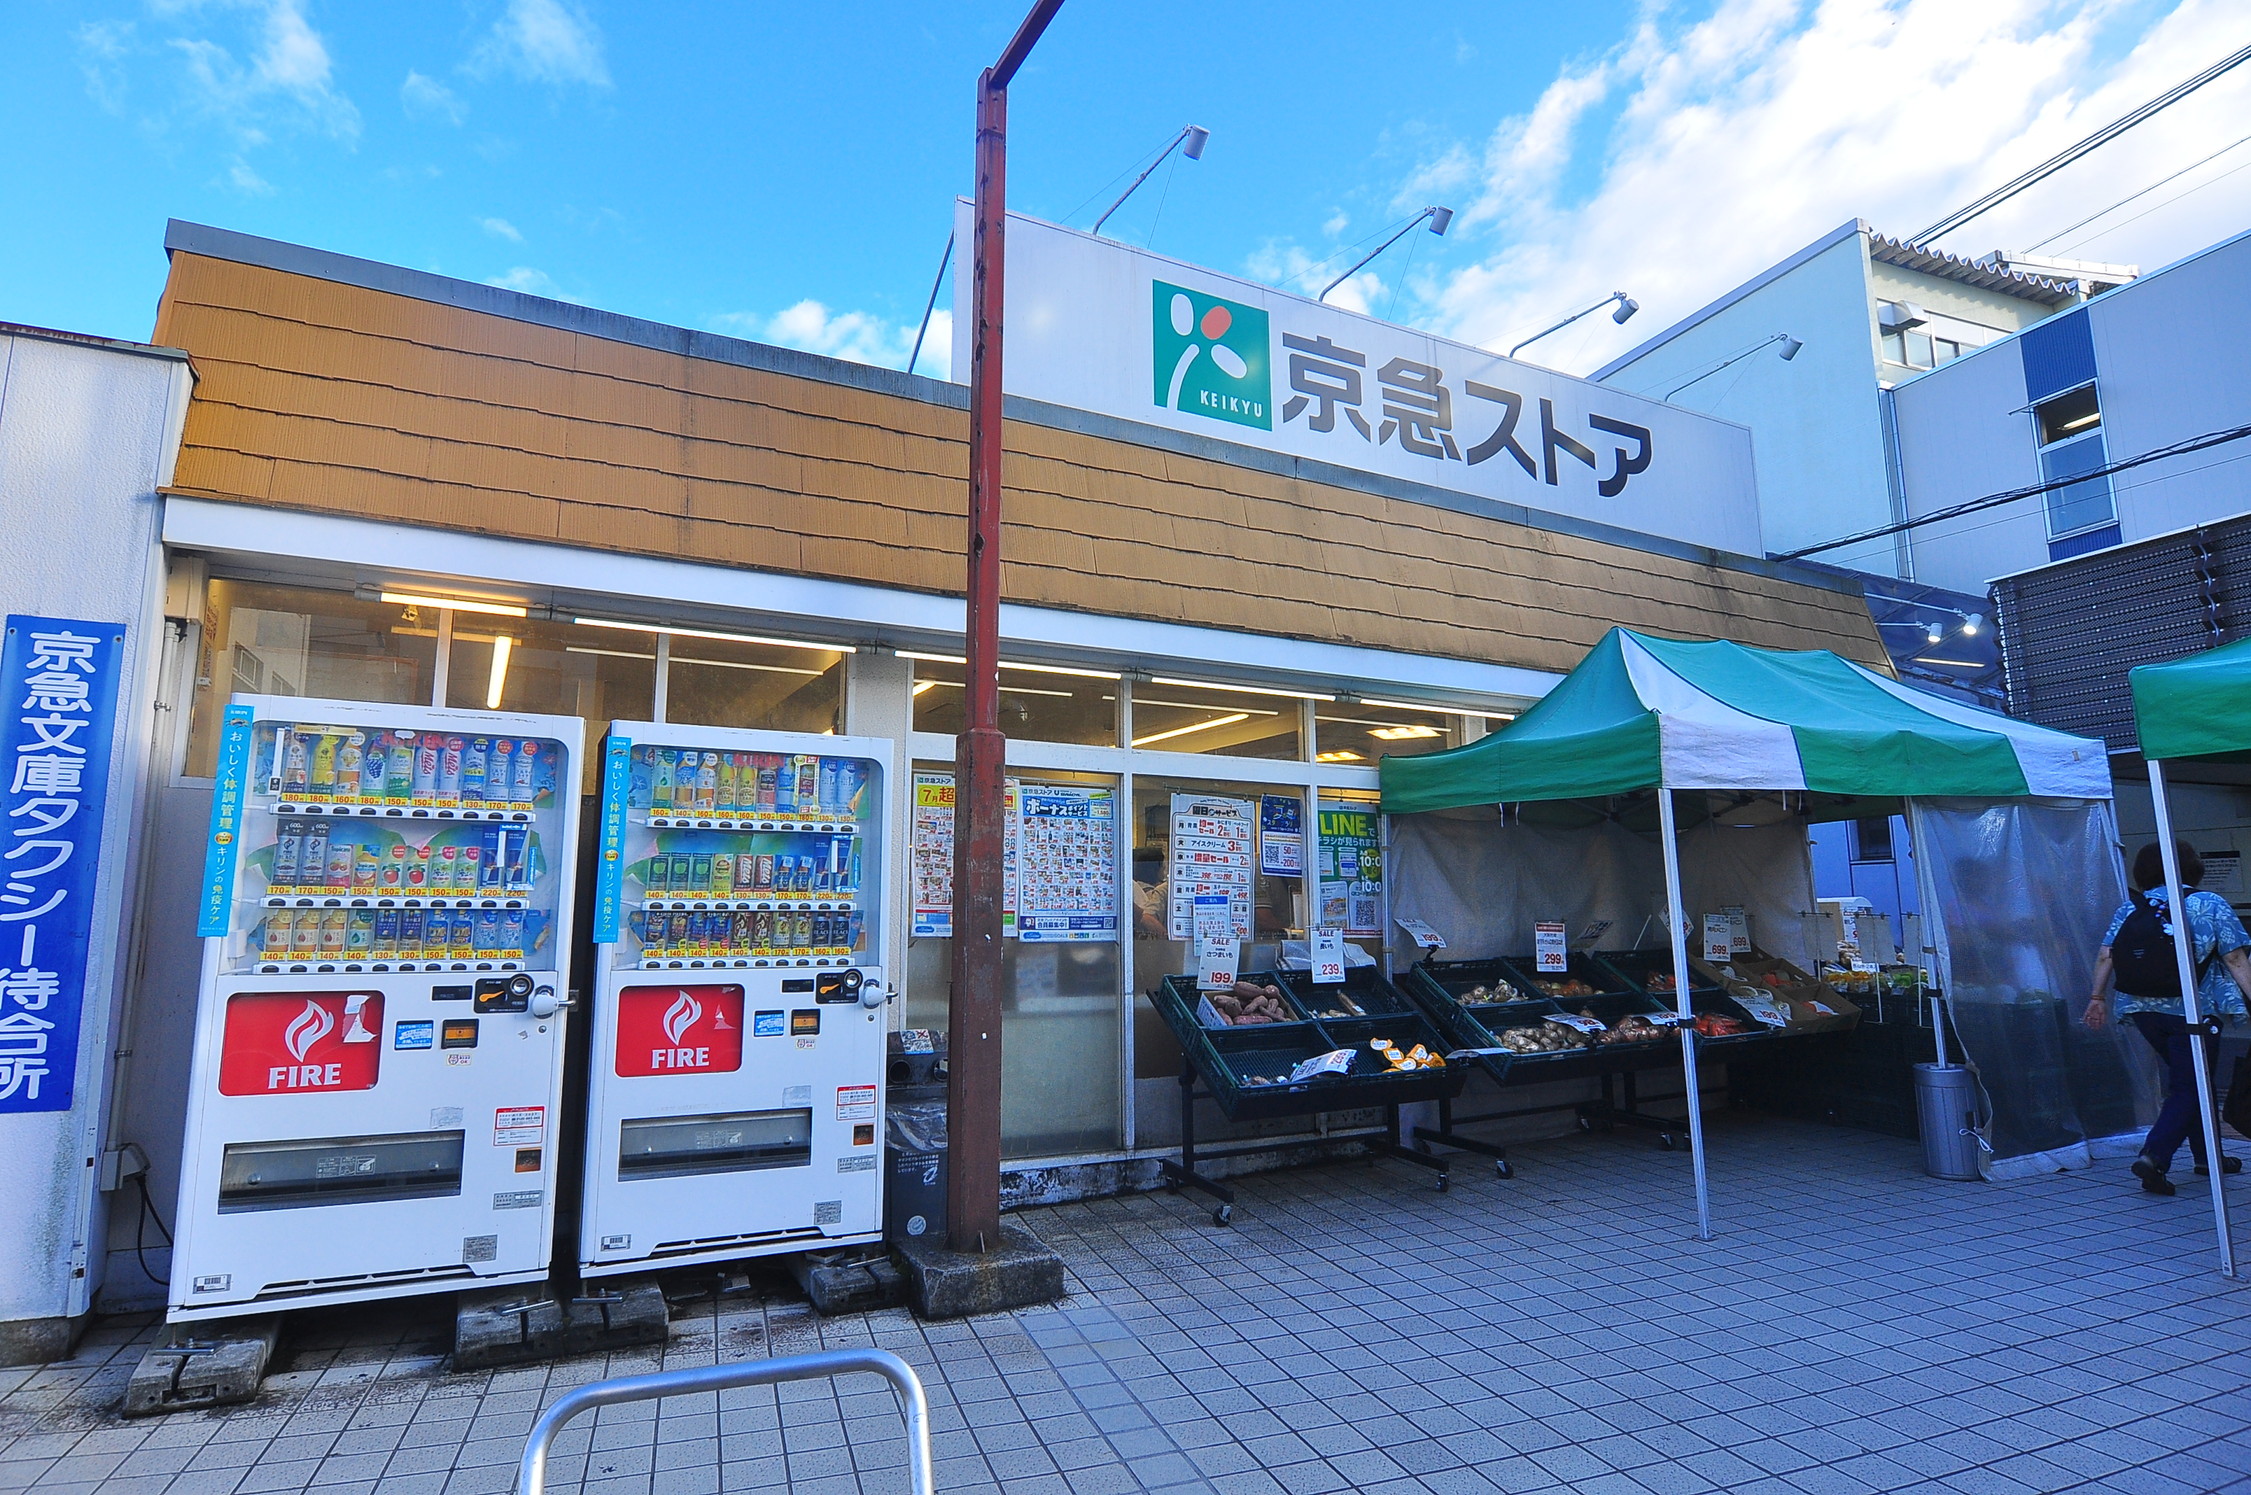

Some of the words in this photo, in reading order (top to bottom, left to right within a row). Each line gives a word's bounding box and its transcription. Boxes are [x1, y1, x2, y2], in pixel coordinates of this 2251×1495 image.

[1200, 389, 1262, 417] KEIKYU
[1282, 332, 1652, 497] 京急ストア
[217, 732, 243, 829] おいしく体調管理
[606, 761, 623, 849] おいしく体調管理
[1026, 798, 1068, 816] ボーナス
[1191, 840, 1226, 848] アイスクリーム
[1227, 840, 1236, 851] 3
[0, 630, 101, 1099] 京急文庫タクシー待合所
[209, 846, 228, 925] キリンの免疫ケア
[1206, 951, 1234, 959] さつまいも
[1211, 938, 1231, 946] SALE
[651, 1047, 710, 1069] FIRE
[267, 1063, 342, 1089] FIRE
